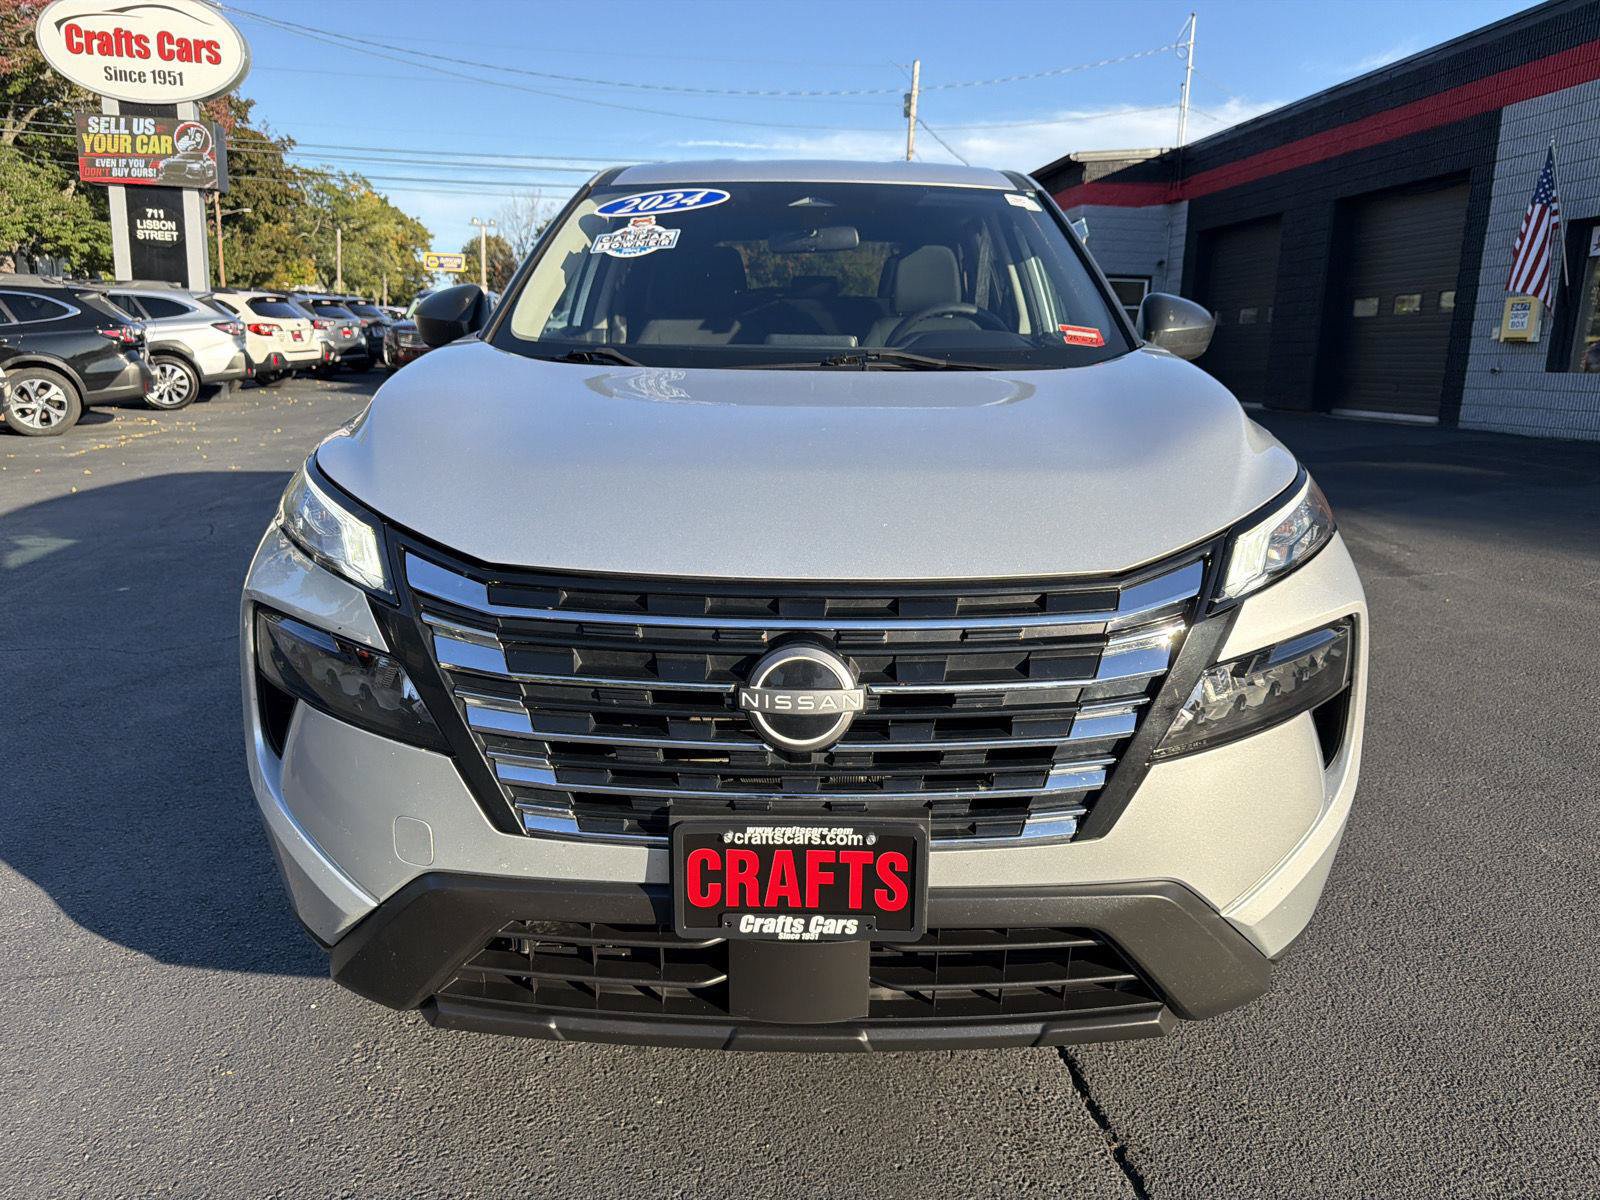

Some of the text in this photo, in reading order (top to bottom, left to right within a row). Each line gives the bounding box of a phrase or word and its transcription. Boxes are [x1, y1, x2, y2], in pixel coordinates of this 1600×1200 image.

[64, 23, 222, 65] Crafts Cars
[103, 66, 184, 86] Since 1951
[88, 116, 156, 135] SELL US
[82, 133, 173, 154] YOUR CAR
[95, 158, 145, 168] EVEN IF YOU
[84, 167, 157, 178] DON'T BUY OURS!
[614, 191, 708, 214] 2024
[145, 208, 164, 219] 711
[136, 219, 176, 231] LISBON
[136, 230, 179, 242] STREET
[1511, 320, 1525, 329] BOX
[741, 692, 860, 710] NISSAN
[746, 826, 854, 836] www.craftscars.com
[733, 832, 864, 846] craftscars.com
[687, 847, 909, 912] CRAFTS
[740, 914, 859, 935] Crafts Cars
[777, 932, 820, 941] Since 1951
